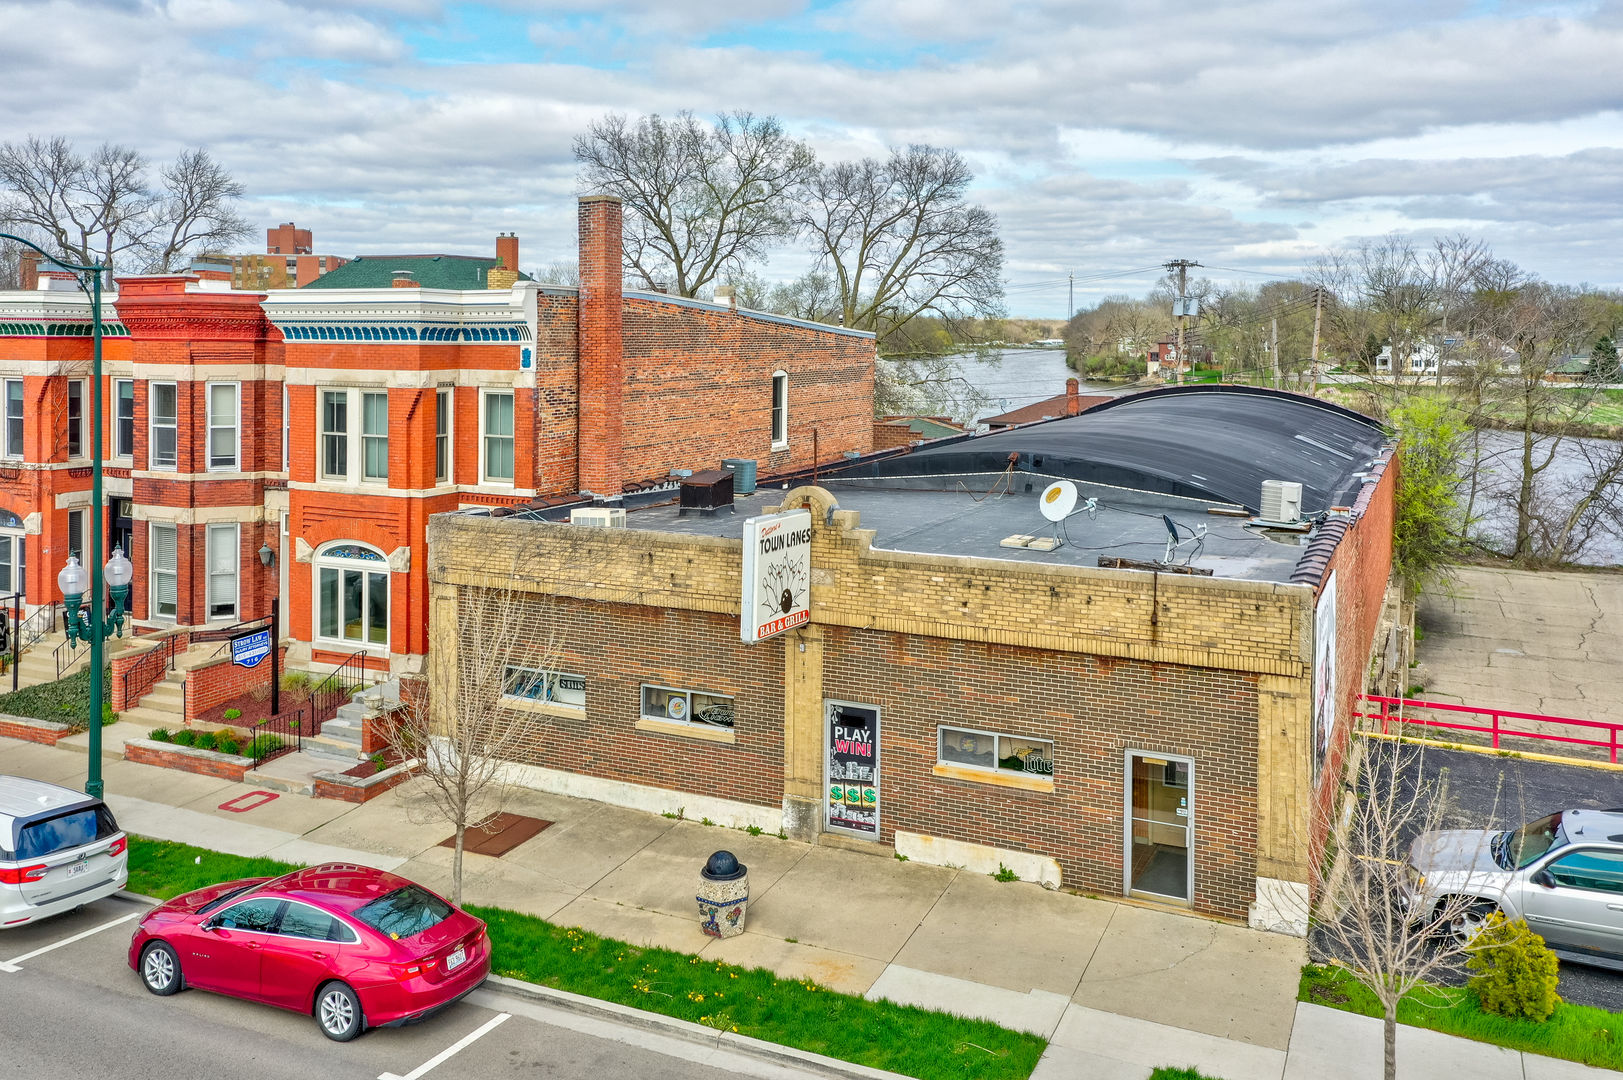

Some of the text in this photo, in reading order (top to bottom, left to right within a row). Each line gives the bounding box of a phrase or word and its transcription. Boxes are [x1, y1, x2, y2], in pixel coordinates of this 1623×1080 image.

[760, 528, 811, 555] TOWN LANES
[760, 611, 808, 636] BAR & GRILL
[246, 656, 259, 665] 716
[835, 739, 872, 757] WIN!
[1023, 754, 1053, 774] Lite
